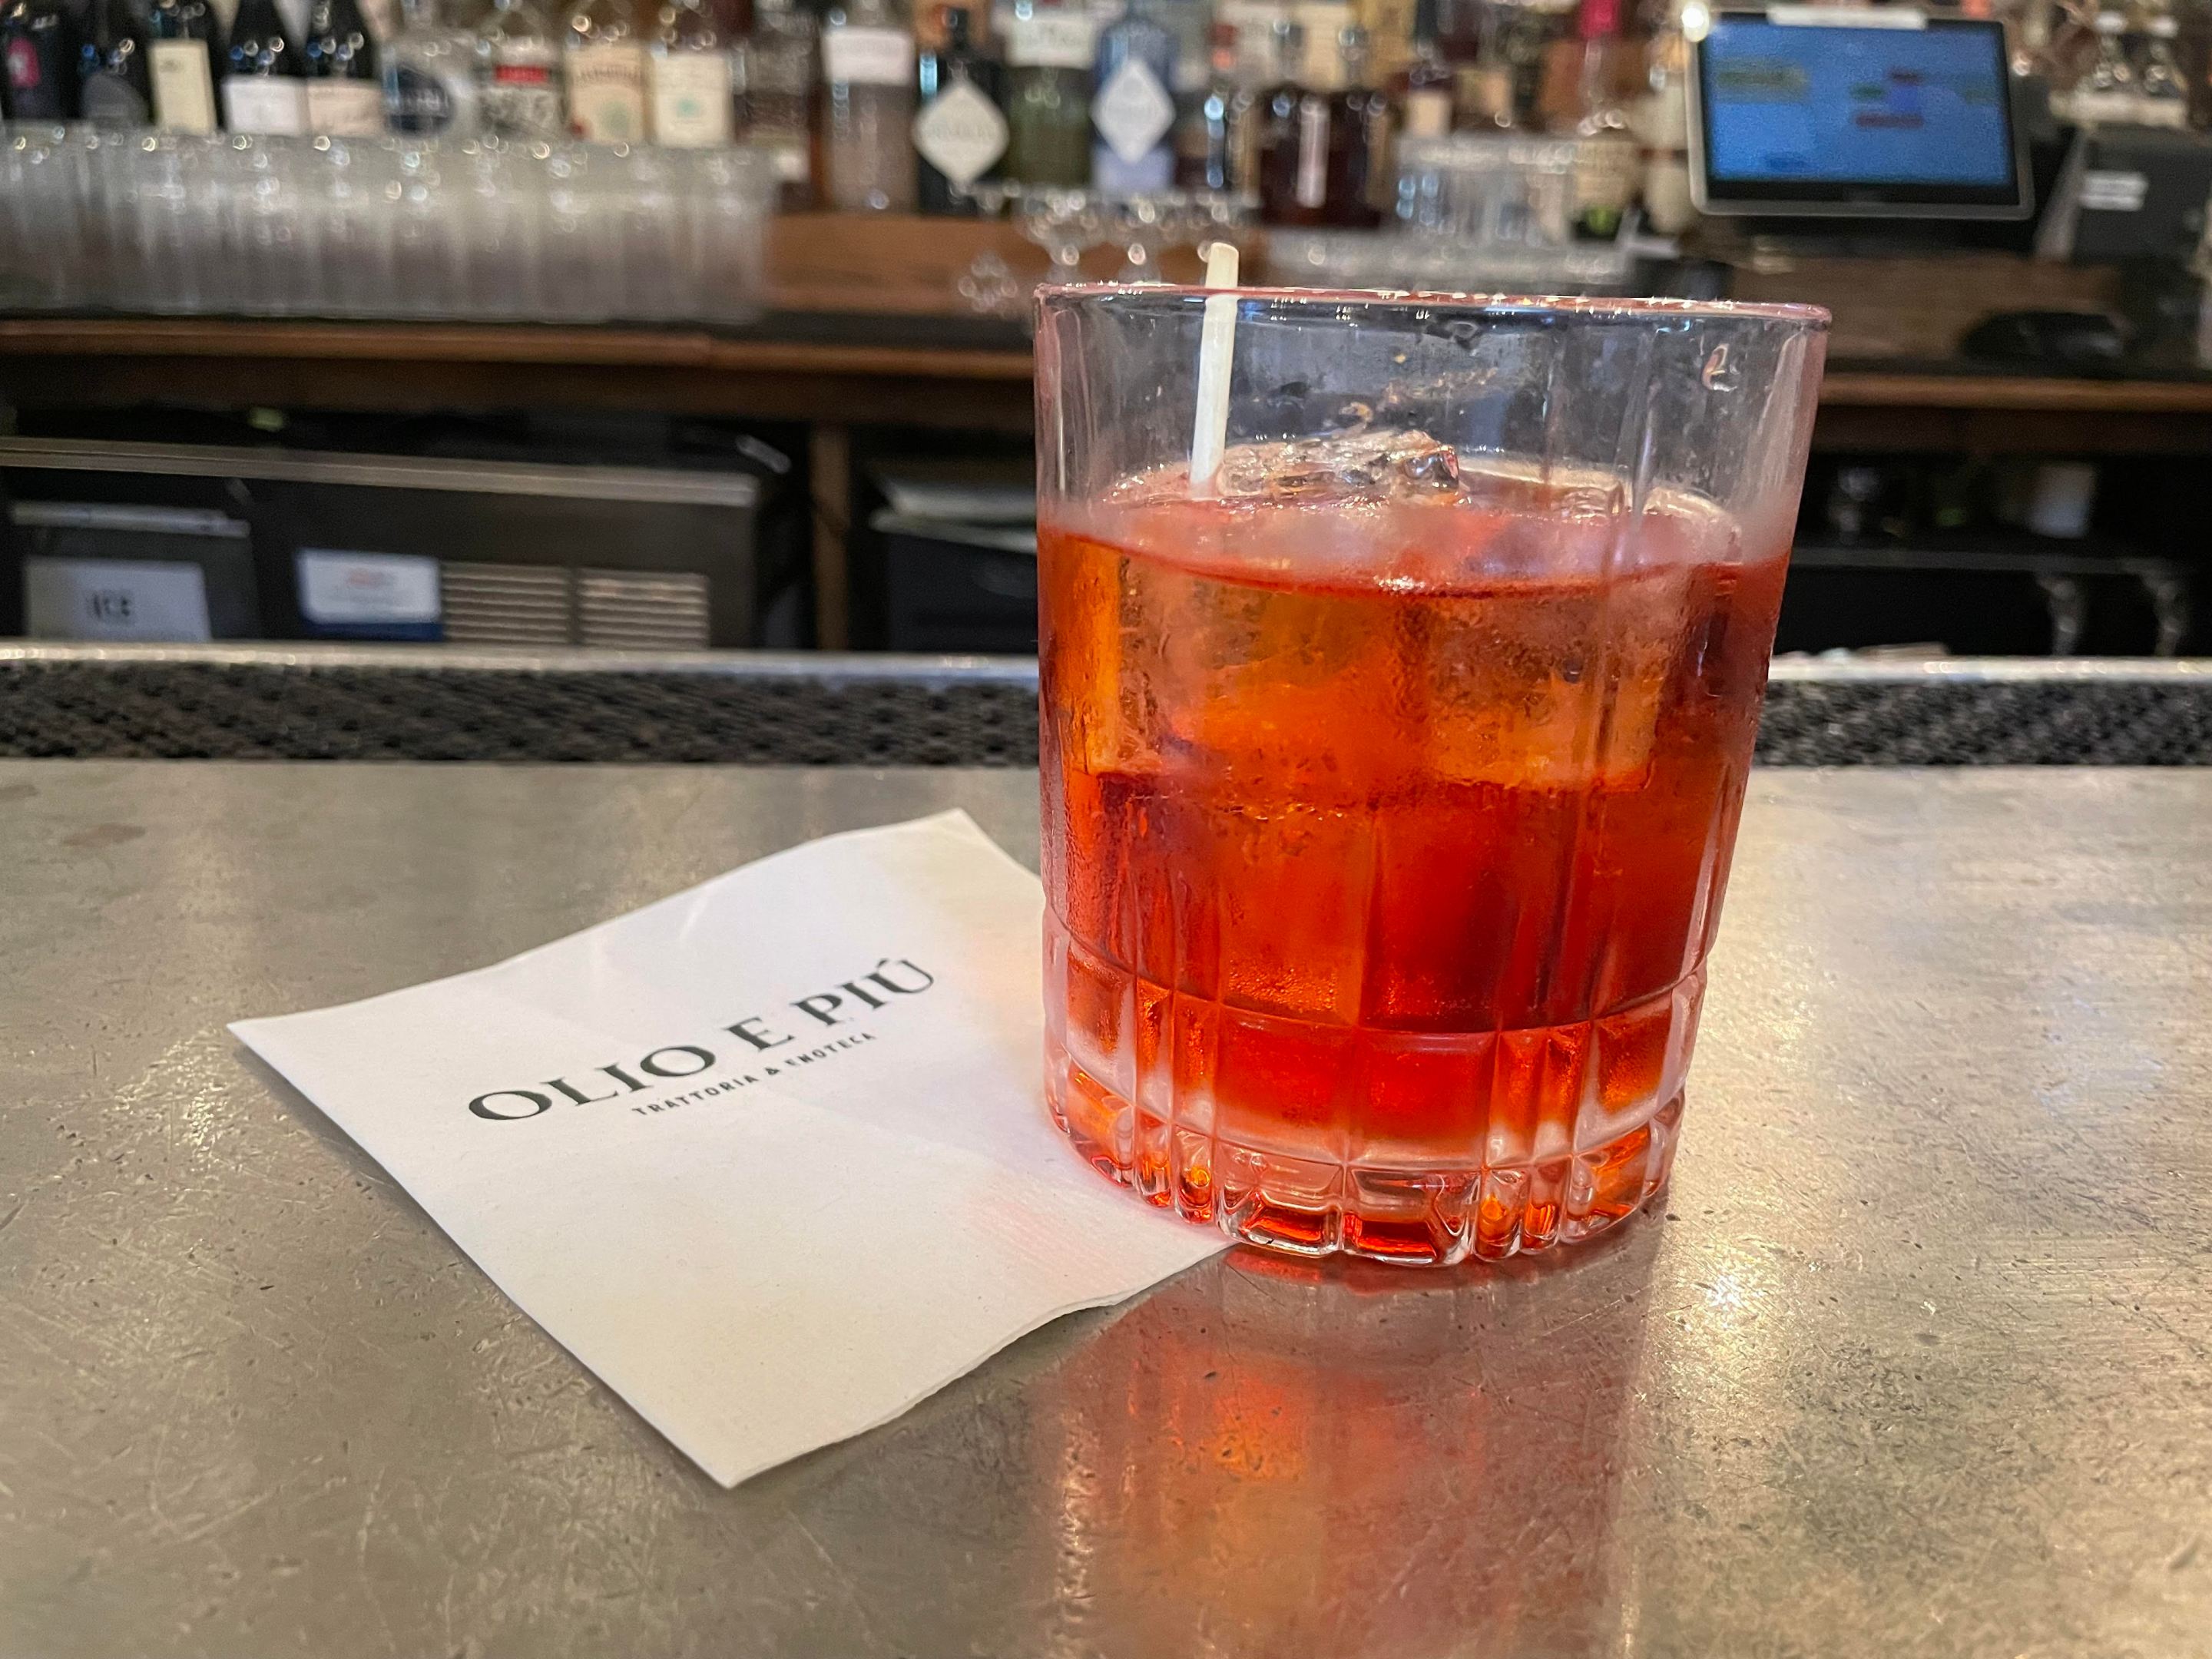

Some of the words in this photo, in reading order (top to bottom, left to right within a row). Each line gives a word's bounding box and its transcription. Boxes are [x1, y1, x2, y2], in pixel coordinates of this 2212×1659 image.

[469, 1045, 717, 1121] OLIO
[724, 1016, 796, 1053] E
[632, 1075, 760, 1115] TRATTORIA
[764, 1066, 781, 1077] &
[784, 1032, 876, 1067] ENOTECA
